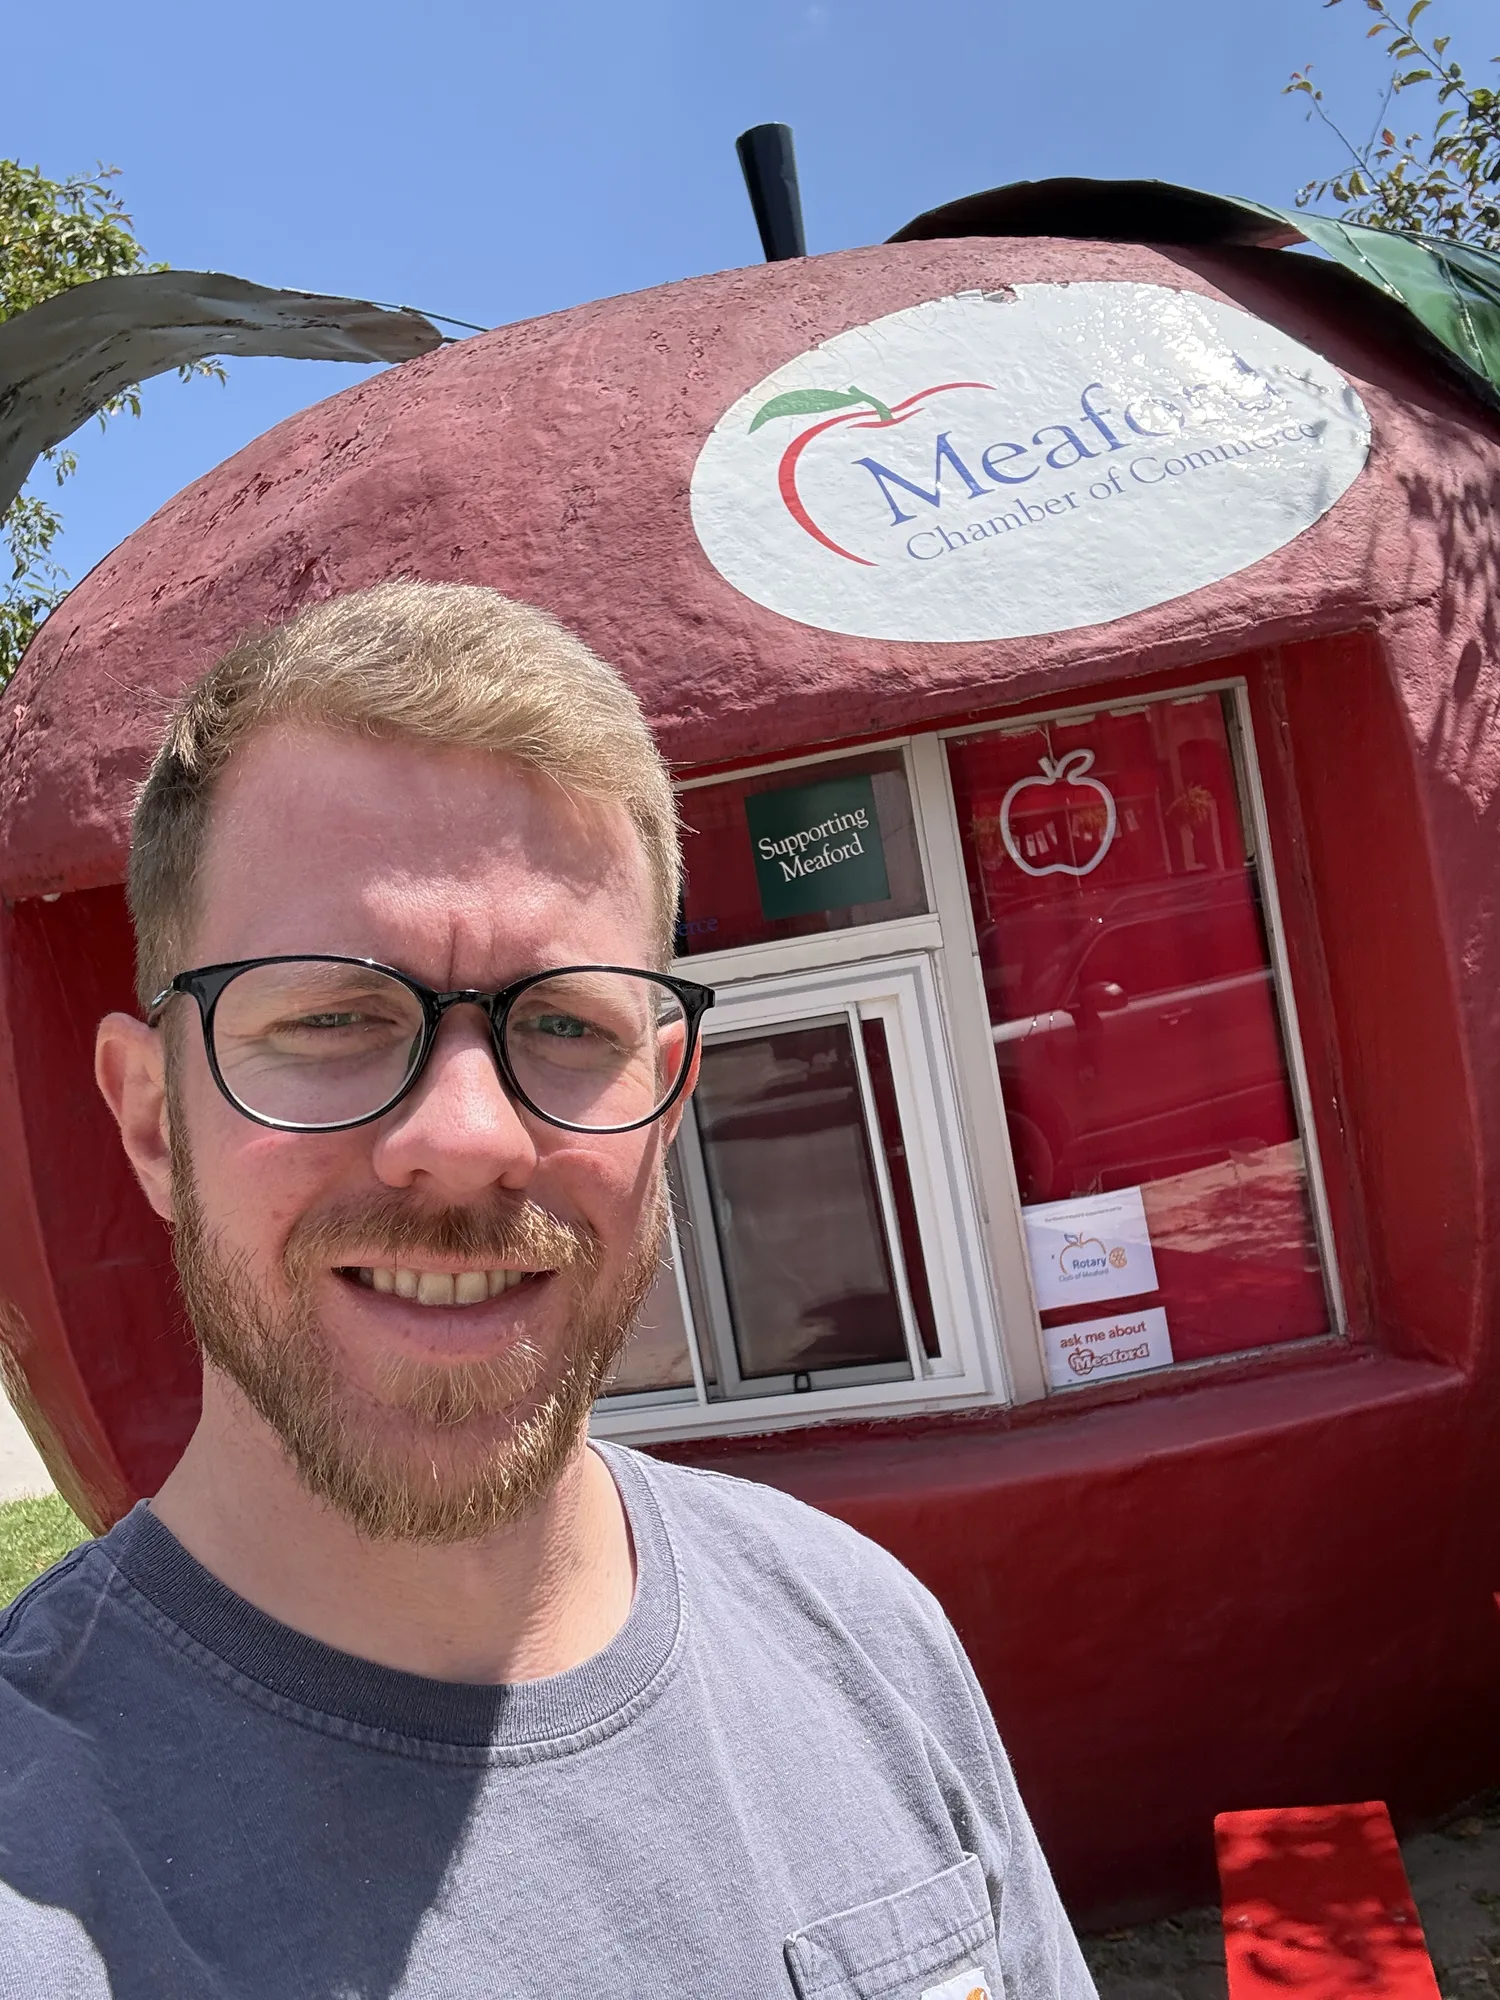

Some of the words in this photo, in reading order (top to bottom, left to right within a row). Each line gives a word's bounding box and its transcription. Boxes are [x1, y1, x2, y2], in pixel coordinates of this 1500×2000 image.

[906, 491, 1081, 560] Chamber
[1089, 465, 1127, 501] of
[1129, 421, 1321, 484] Commerce
[758, 807, 869, 860] Supporting
[778, 832, 865, 882] Meaford
[678, 918, 719, 937] erce
[1072, 1257, 1107, 1270] Rotary
[1060, 1333, 1083, 1348] ask
[1085, 1331, 1106, 1344] me
[1108, 1321, 1147, 1339] about
[1072, 1342, 1150, 1371] Meaford
